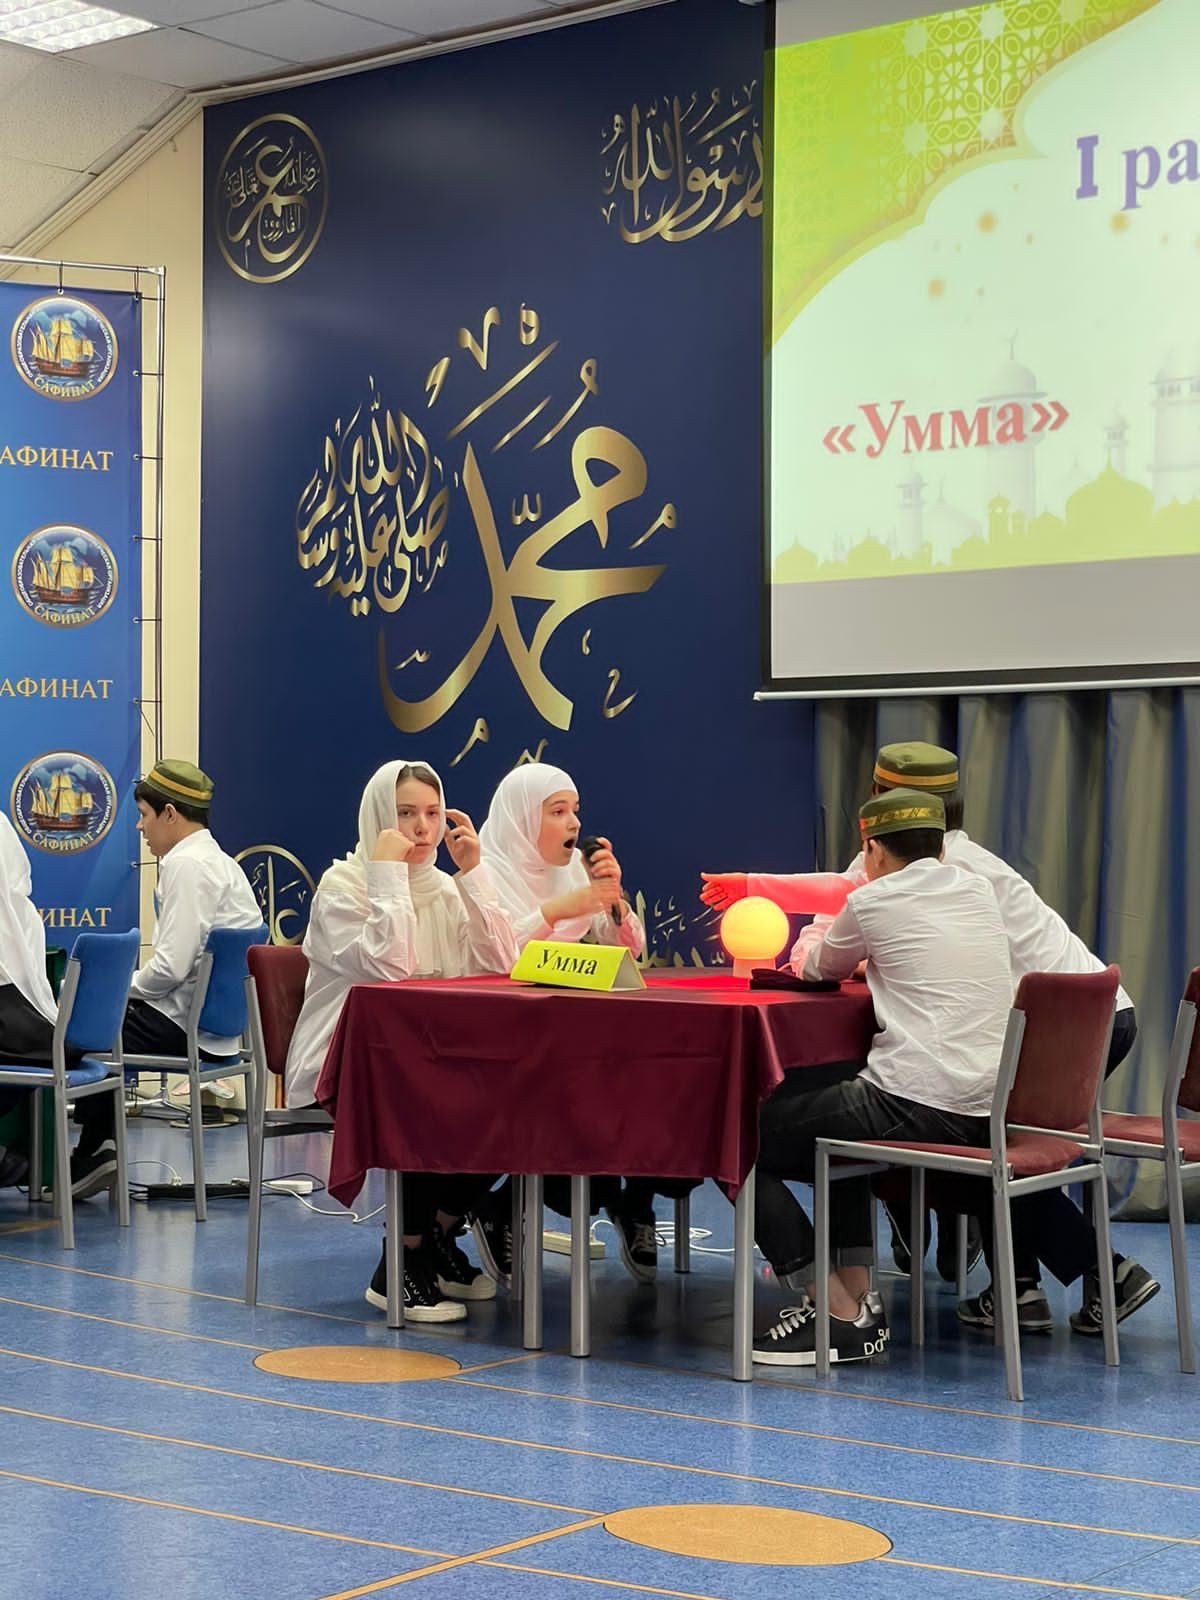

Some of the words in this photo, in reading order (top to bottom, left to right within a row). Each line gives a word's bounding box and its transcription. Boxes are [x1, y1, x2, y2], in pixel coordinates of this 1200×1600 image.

[1120, 139, 1200, 211] ра
[34, 376, 96, 398] САФИНАТ
[821, 399, 1070, 459] «Умма»
[0, 445, 114, 472] АФИНАТ
[34, 603, 96, 624] САФИНАТ
[0, 677, 114, 700] АФИНАТ
[32, 831, 94, 851] САФИНАТ
[38, 907, 112, 928] ИНАТ
[537, 949, 598, 975] Умма
